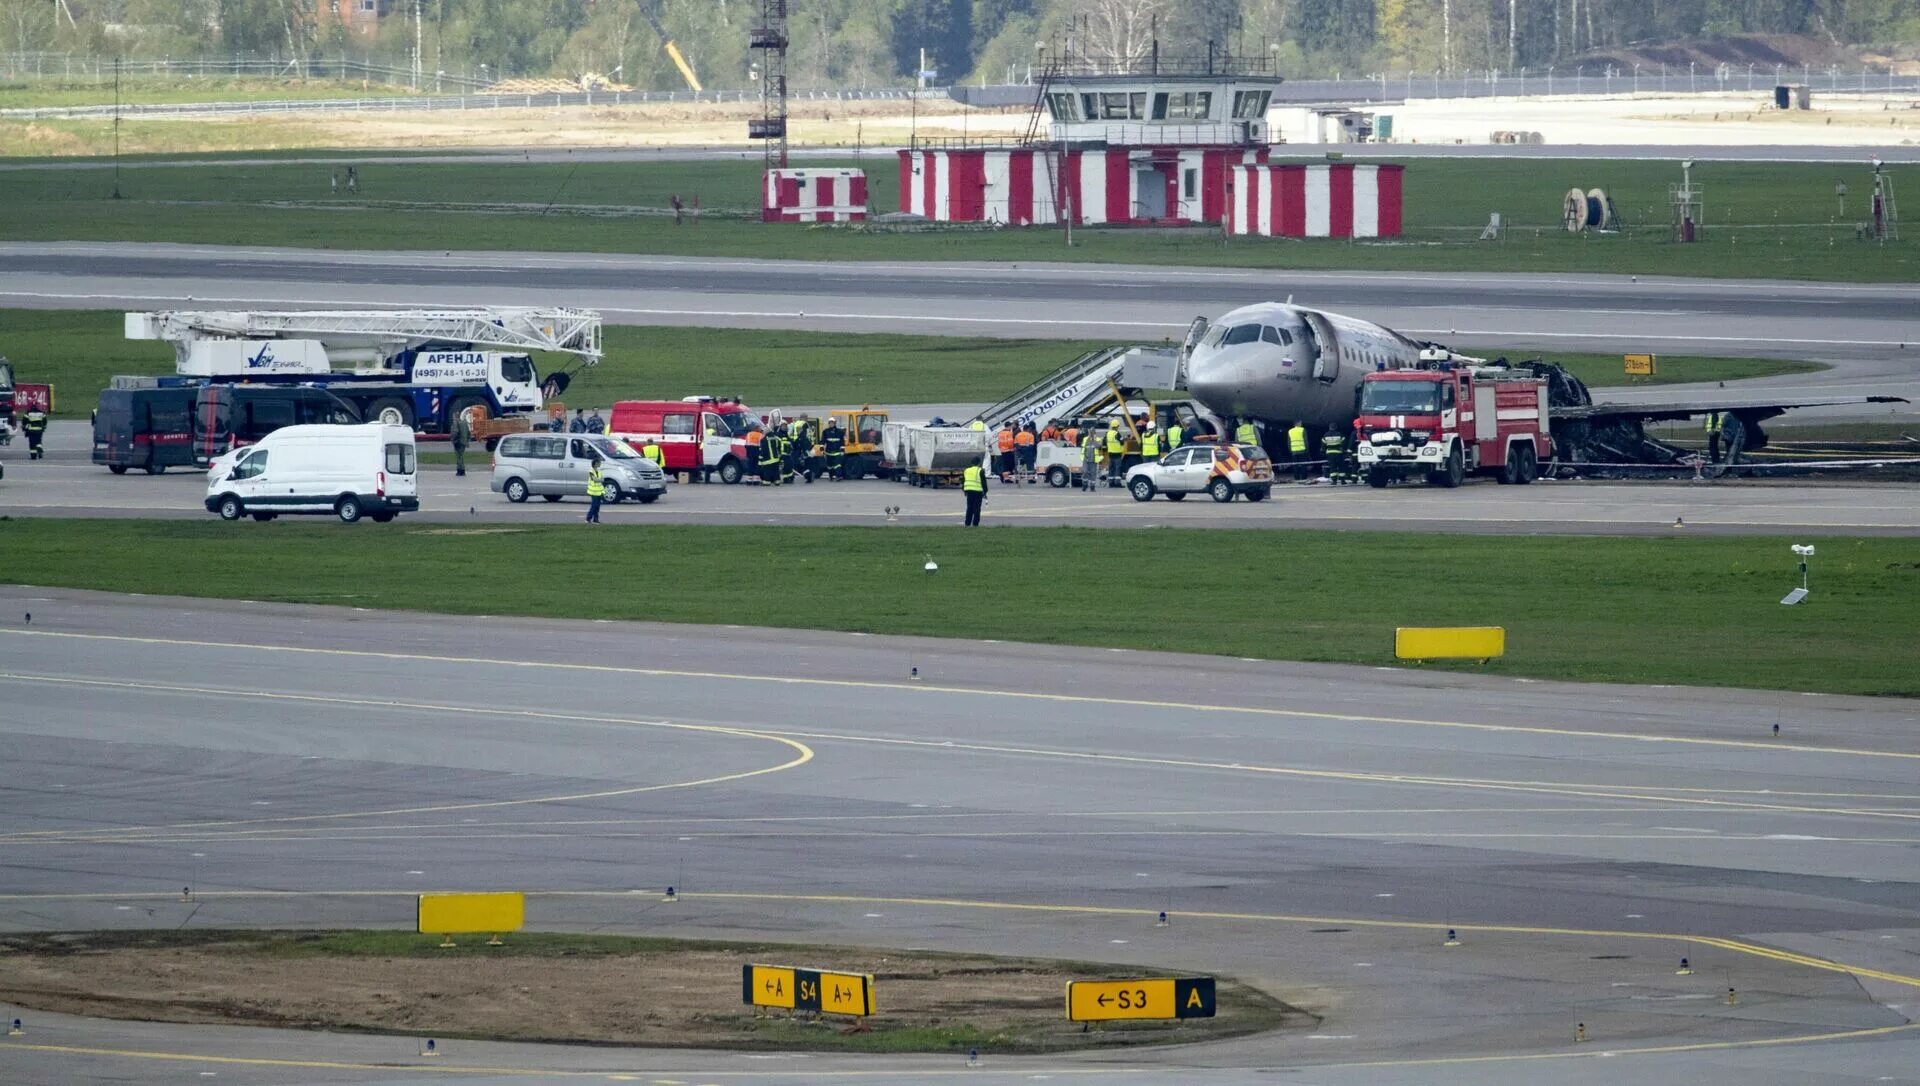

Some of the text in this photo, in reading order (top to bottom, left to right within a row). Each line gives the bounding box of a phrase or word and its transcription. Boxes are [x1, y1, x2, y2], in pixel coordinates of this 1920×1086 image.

[428, 354, 484, 364] АРЕНДА
[1018, 385, 1079, 426] ЭРОФЛОТ
[775, 977, 842, 1004] A S4 A
[1117, 986, 1203, 1010] S3 A
